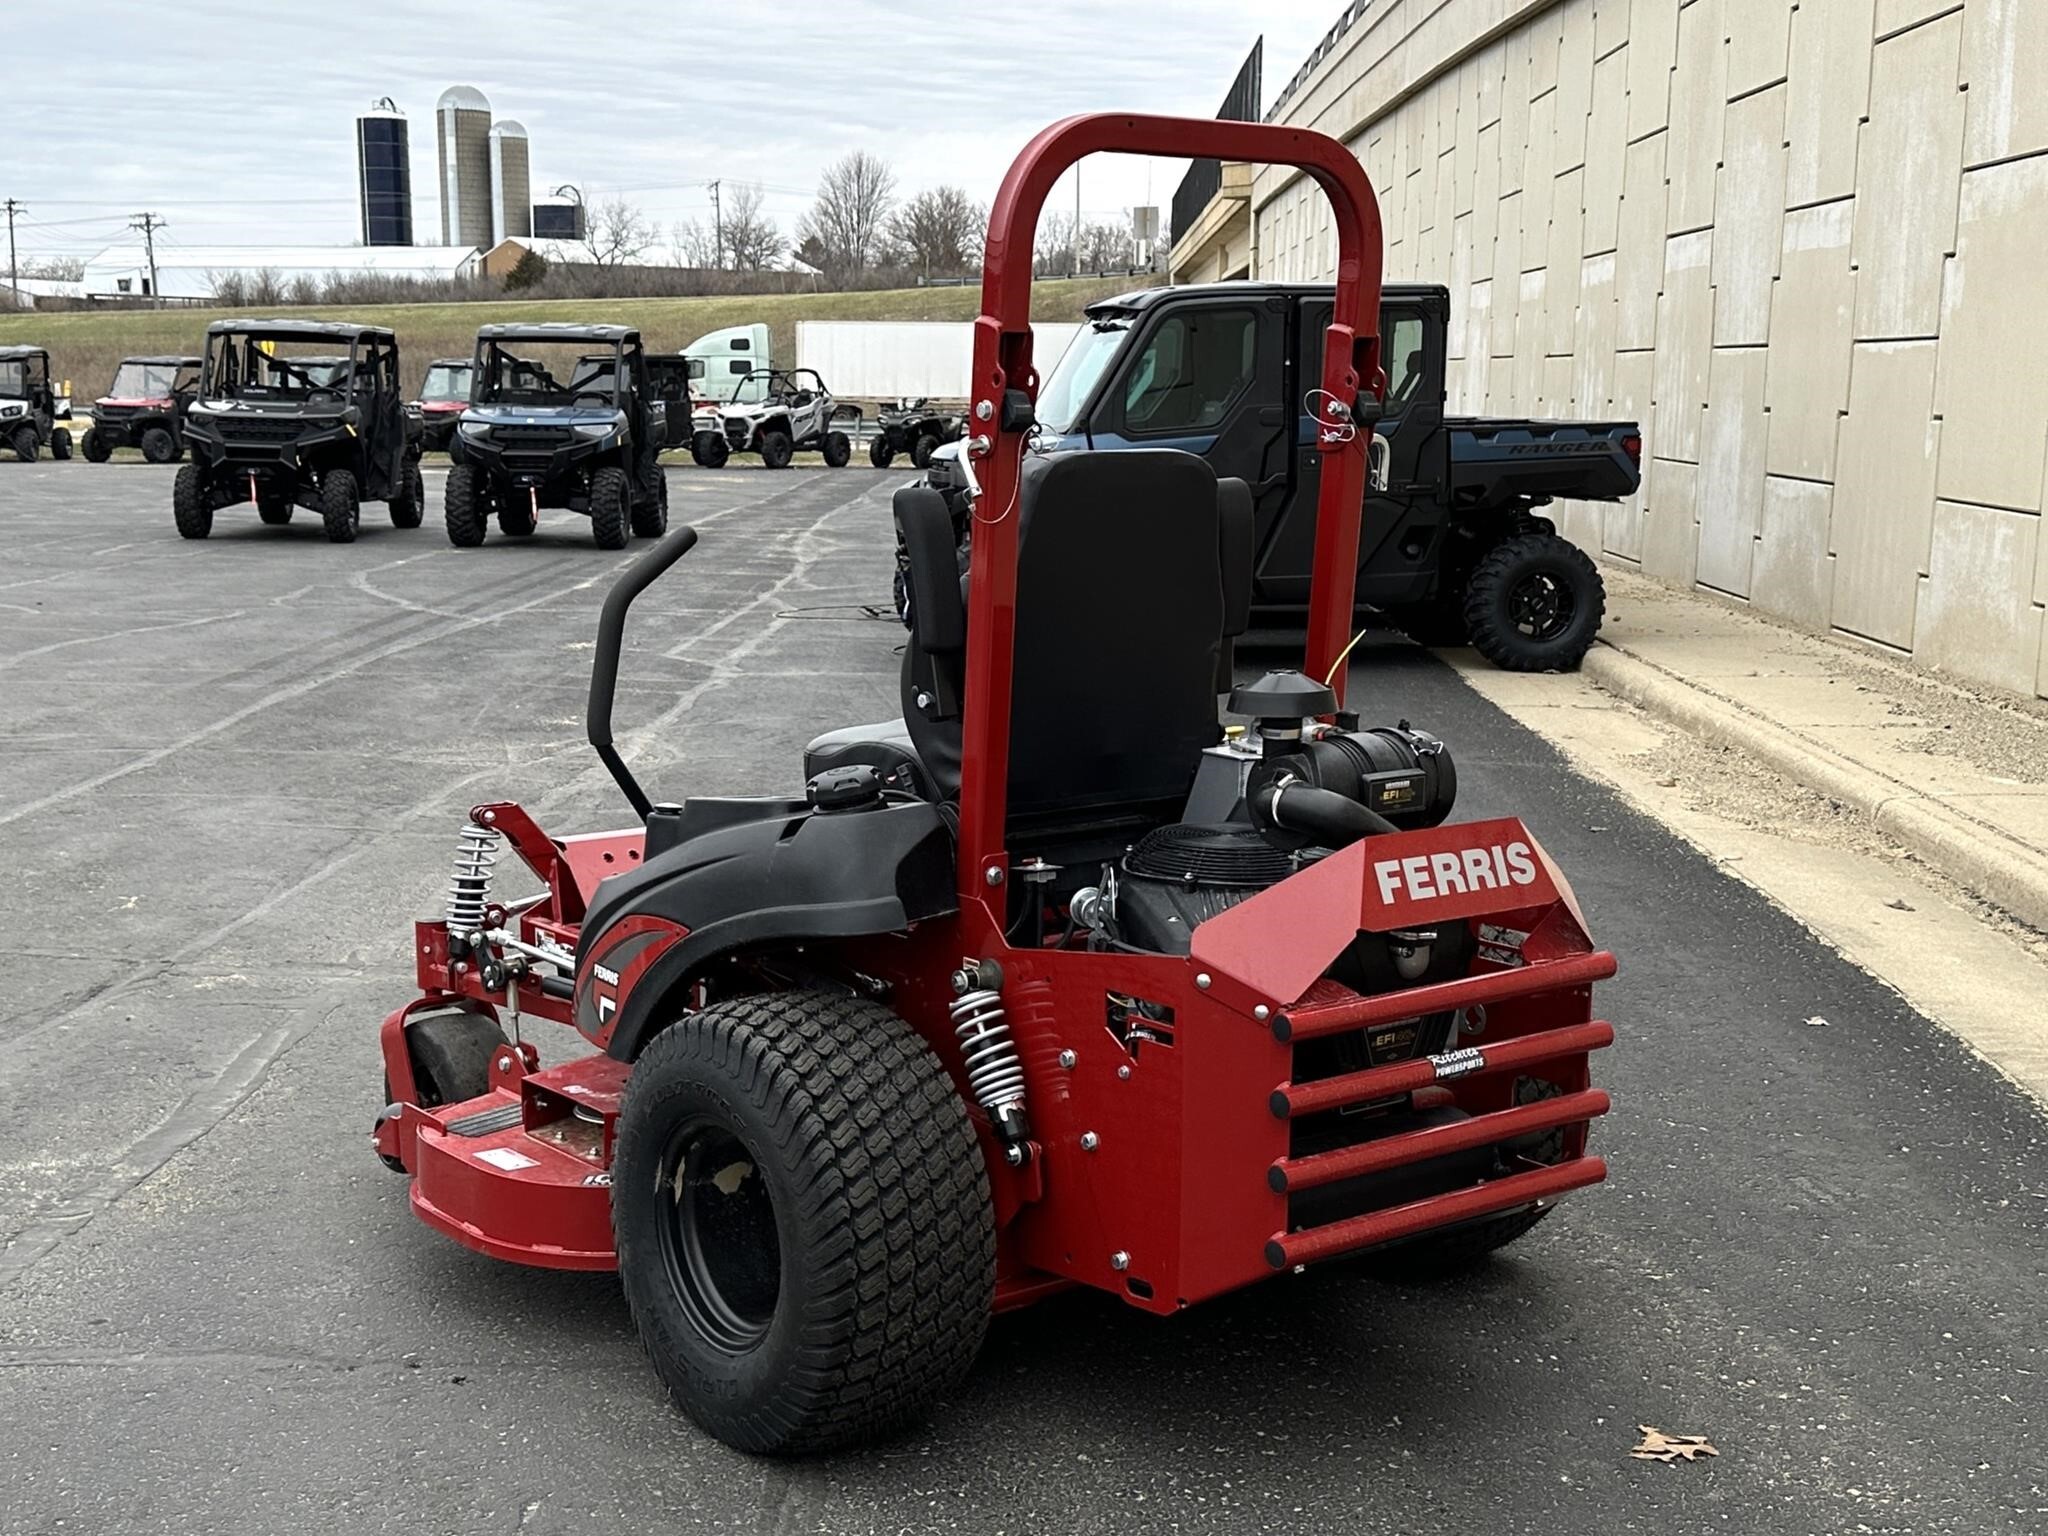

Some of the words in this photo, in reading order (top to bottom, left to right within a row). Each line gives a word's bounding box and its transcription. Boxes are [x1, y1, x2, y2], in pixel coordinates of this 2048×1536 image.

[1509, 441, 1612, 455] RANGER
[1383, 790, 1399, 800] EFI
[1373, 842, 1536, 905] FERRIS
[594, 963, 619, 986] FERRIS
[1376, 1033, 1395, 1046] EFI
[1436, 1057, 1484, 1078] POWERSPORTS
